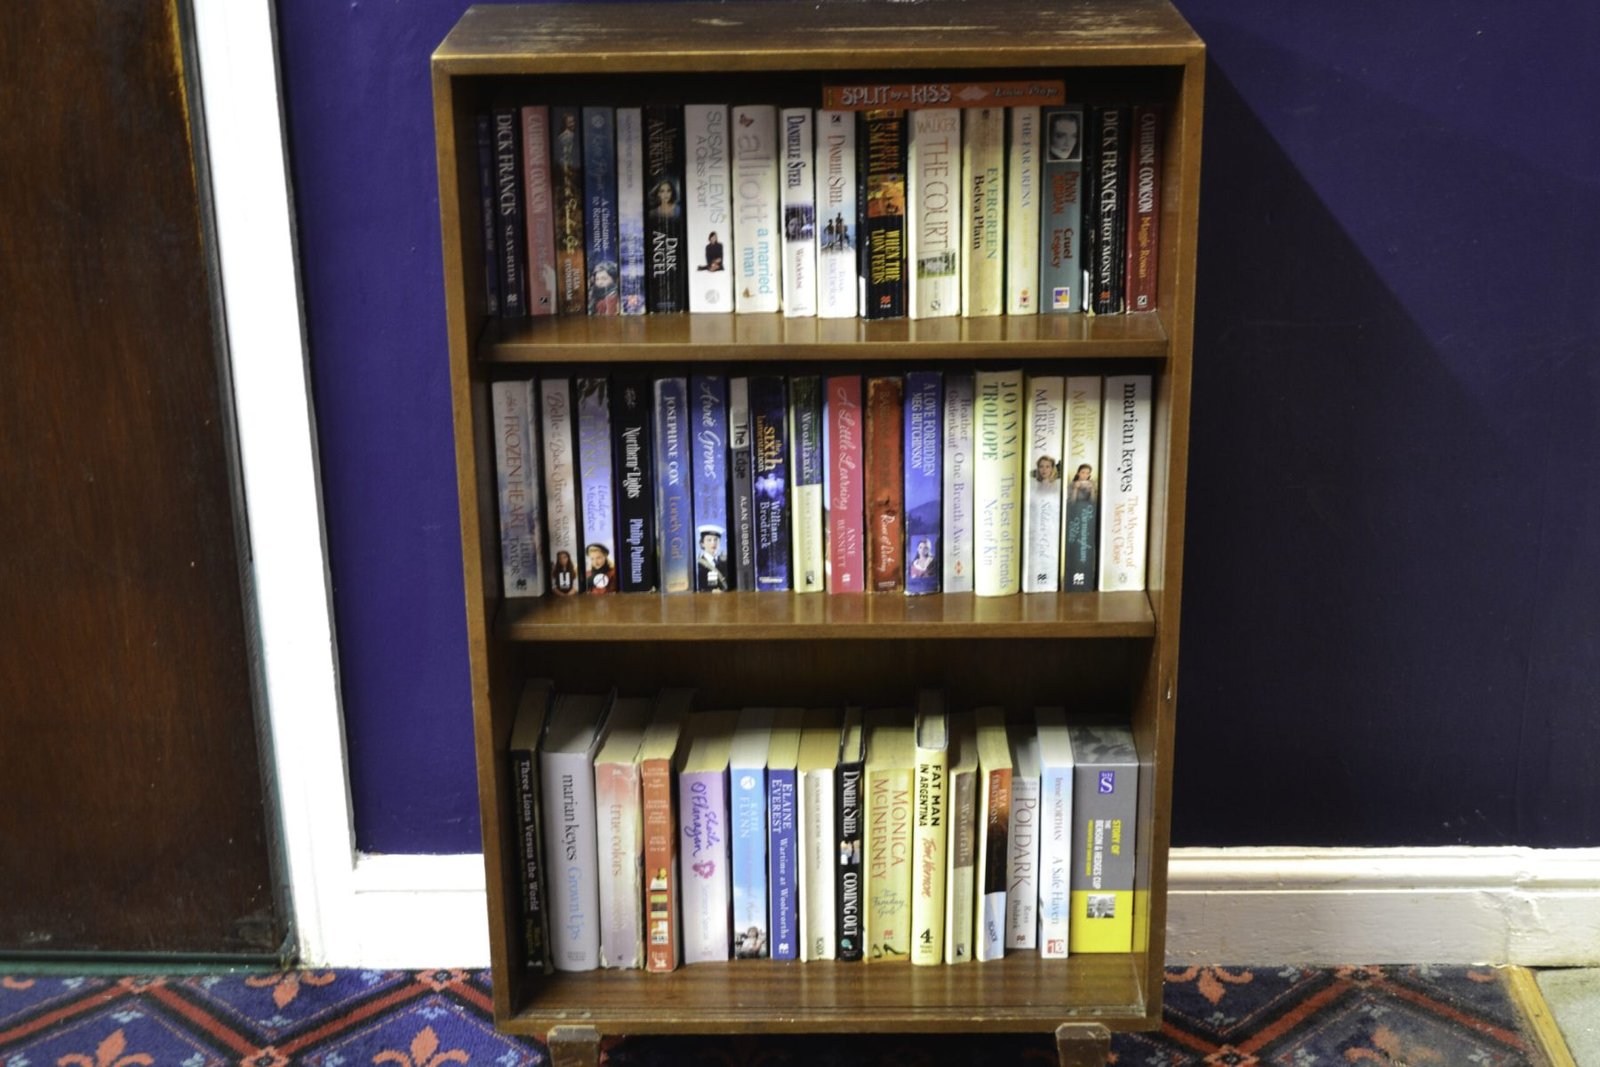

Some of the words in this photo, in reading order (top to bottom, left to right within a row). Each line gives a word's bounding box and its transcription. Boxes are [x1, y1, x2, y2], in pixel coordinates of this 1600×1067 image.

[842, 87, 890, 105] SPLIT
[911, 85, 951, 103] KISS
[496, 114, 513, 151] DICK
[528, 114, 545, 166] CATHERINE
[696, 135, 705, 144] A
[707, 111, 723, 168] SUSAN
[787, 115, 806, 158] DANIELLE
[1022, 114, 1032, 138] THE
[1102, 111, 1119, 149] DICK
[1139, 114, 1155, 165] CATHERINE
[649, 119, 663, 176] ANDREWS
[696, 146, 706, 177] Class
[828, 135, 846, 176] DANIELLE
[870, 123, 885, 173] SMITH
[884, 121, 900, 170] WILBUR
[923, 136, 948, 177] THE
[498, 154, 516, 216] FRANCIS
[529, 168, 547, 214] COOKSON
[697, 179, 708, 208] Apart
[787, 161, 806, 189] STEEL
[828, 176, 846, 208] STEEL
[973, 175, 985, 213] Belva
[1021, 169, 1031, 208] ARENA
[1100, 151, 1118, 213] FRANCIS
[1138, 167, 1153, 214] COOKSON
[709, 175, 726, 224] LEWIS
[923, 181, 949, 249] COURT
[986, 167, 998, 260] EVERGREEN
[592, 207, 603, 253] Remember
[757, 228, 768, 237] a
[872, 229, 885, 253] LION
[885, 229, 900, 259] WHEN
[973, 216, 984, 250] Plain
[1051, 229, 1063, 269] Legacy
[1063, 228, 1074, 259] Cruel
[1102, 217, 1112, 243] HOT
[652, 231, 665, 278] ANGEL
[665, 237, 678, 272] DARK
[742, 247, 756, 278] man
[758, 241, 773, 294] married
[870, 254, 885, 285] FEEDS
[885, 261, 900, 282] THE
[1101, 244, 1112, 285] MONEY
[546, 392, 564, 427] Belle
[699, 382, 718, 427] Annie
[912, 392, 922, 411] MEG
[924, 392, 936, 418] LOVE
[948, 390, 958, 449] Gudenkauf
[961, 400, 971, 441] Heather
[1001, 381, 1017, 460] JOANNA
[1035, 389, 1048, 452] MURRAY
[1047, 405, 1057, 436] Annie
[1122, 382, 1137, 445] marian
[665, 396, 679, 458] JOSEPHINE
[734, 424, 747, 446] The
[838, 410, 856, 451] Little
[982, 382, 998, 461] TROLLOPE
[1071, 389, 1086, 459] MURRAY
[1086, 408, 1096, 441] Annie
[503, 415, 523, 476] FROZEN
[621, 426, 641, 467] Northern
[697, 431, 721, 480] Groves
[756, 415, 766, 473] lamentation
[764, 427, 783, 471] sixth
[801, 411, 812, 480] Woodlands
[911, 413, 923, 469] HUTCHINSON
[923, 419, 936, 477] FORBIDDEN
[622, 467, 642, 499] Lights
[668, 461, 680, 487] COX
[735, 451, 746, 479] Edge
[833, 452, 855, 511] Learning
[953, 452, 965, 479] One
[1116, 448, 1136, 493] keyes
[597, 485, 608, 518] Under
[953, 482, 964, 523] Breath
[1001, 473, 1015, 498] The
[1128, 496, 1138, 513] The
[507, 480, 525, 531] HEART
[770, 500, 781, 543] William
[983, 499, 997, 528] Next
[1001, 503, 1014, 527] Best
[1111, 503, 1125, 533] Mercy
[626, 518, 644, 544] Philip
[759, 501, 770, 549] Brodrick
[837, 519, 845, 568] BENNETT
[847, 527, 856, 558] ANNE
[950, 526, 964, 558] Away
[983, 531, 997, 543] of
[1001, 531, 1014, 543] of
[1125, 515, 1137, 556] Mystery
[510, 536, 521, 575] TAYLOR
[520, 542, 530, 569] LULU
[741, 523, 750, 566] GIBBONS
[983, 545, 997, 566] Kin
[1113, 536, 1124, 565] Close
[630, 546, 644, 584] Pullman
[1000, 546, 1013, 589] Friends
[520, 760, 531, 791] Three
[920, 764, 929, 774] IN
[931, 765, 941, 791] FAT
[1054, 777, 1063, 798] Irene
[523, 793, 534, 822] Lions
[562, 774, 577, 822] marian
[771, 779, 783, 834] EVEREST
[782, 783, 792, 829] ELAINE
[842, 771, 860, 809] DANIELLE
[918, 776, 929, 827] ARGENTINA
[998, 789, 1007, 808] EVA
[610, 804, 622, 833] true
[684, 782, 711, 857] O'Flanagan
[705, 811, 720, 849] Sheila
[740, 797, 751, 839] FLYNN
[843, 809, 861, 838] STEEL
[871, 779, 889, 880] McINERNEY
[890, 790, 908, 867] MONICA
[930, 795, 940, 827] MAN
[1053, 800, 1062, 841] NORTHAN
[524, 824, 536, 859] Versus
[561, 824, 579, 861] keyes
[922, 838, 936, 860] Tom
[959, 802, 970, 863] Waterfalls
[1010, 797, 1036, 893] POLDARK
[1095, 820, 1104, 845] BENSON
[1111, 844, 1120, 856] OF
[1112, 819, 1121, 843] STORY
[527, 861, 537, 879] the
[611, 835, 626, 877] colors
[779, 838, 788, 874] Wartime
[1052, 856, 1063, 865] A
[1094, 851, 1103, 875] HEDGES
[528, 882, 539, 911] World
[567, 867, 583, 913] Grown
[779, 876, 787, 886] at
[842, 872, 857, 914] COMING
[922, 860, 936, 898] Vernon
[1051, 867, 1063, 889] Safe
[1093, 877, 1101, 889] CUP
[779, 888, 789, 939] Woolworths
[844, 914, 858, 936] OUT
[1051, 891, 1063, 925] Haven
[567, 914, 584, 941] Ups
